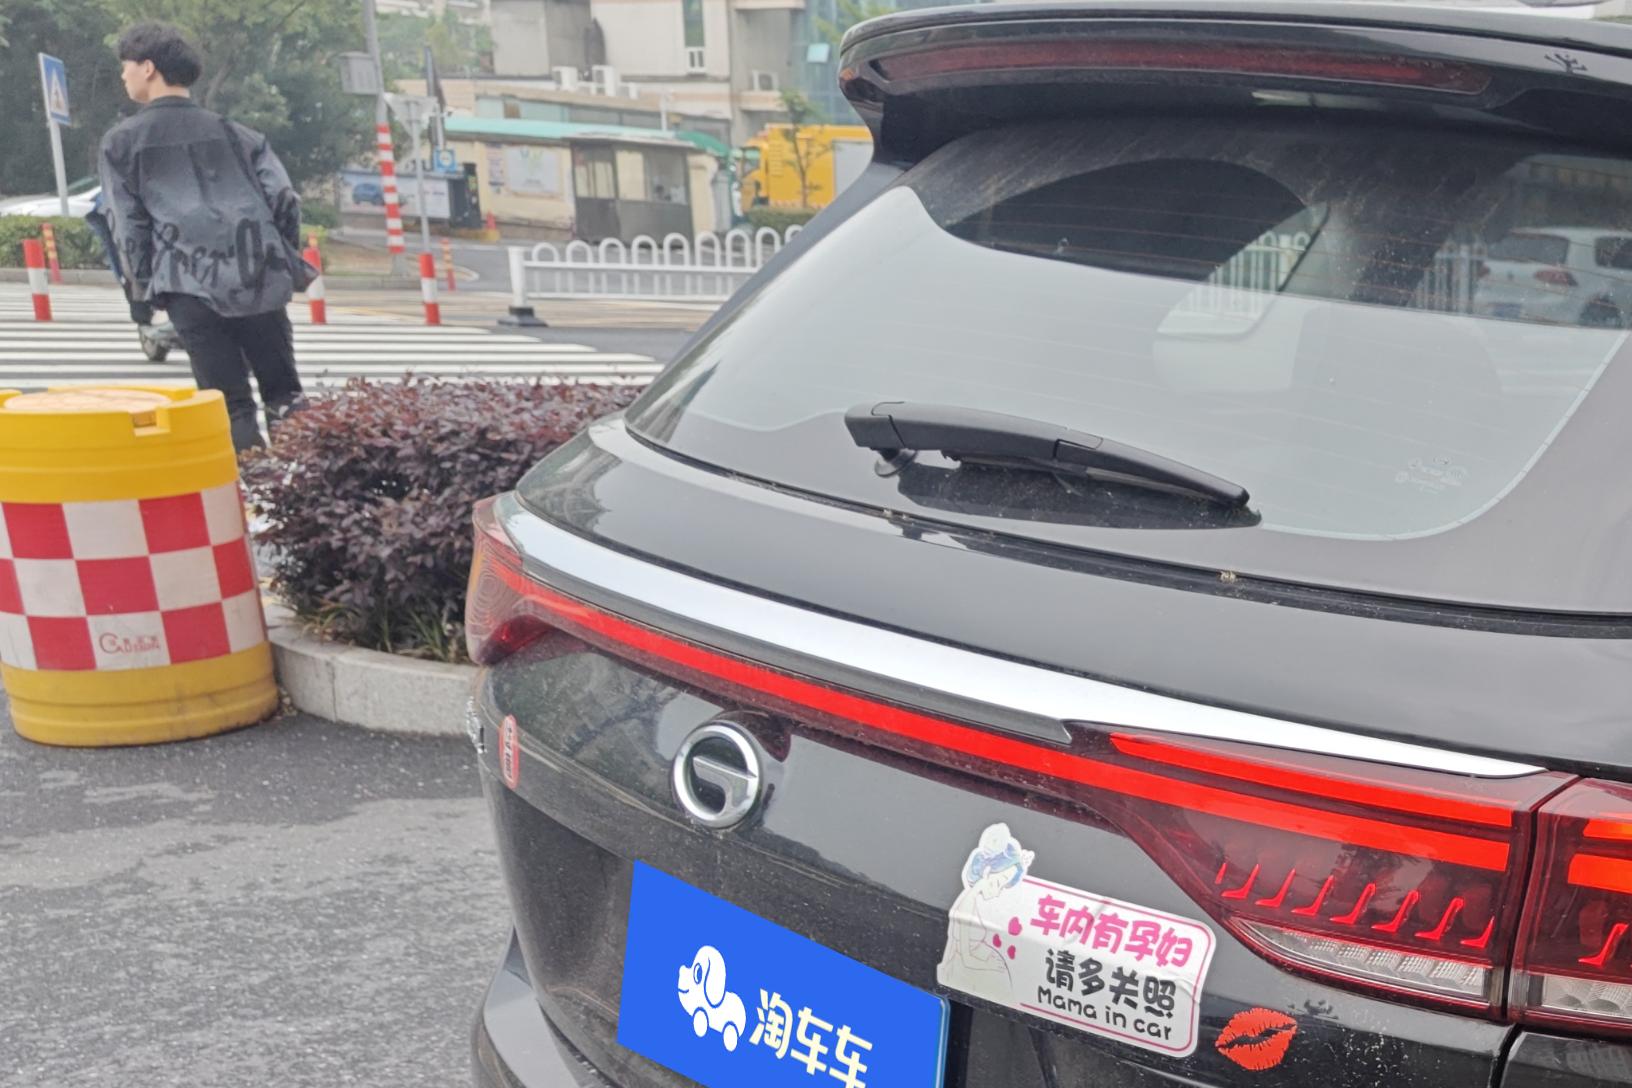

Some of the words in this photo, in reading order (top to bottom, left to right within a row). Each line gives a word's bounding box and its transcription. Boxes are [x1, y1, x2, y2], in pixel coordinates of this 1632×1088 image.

[1030, 894, 1193, 968] 车内有孕妇
[1037, 985, 1097, 1019] Mama
[1105, 1006, 1127, 1028] in
[1133, 1018, 1172, 1040] car
[1045, 948, 1176, 1019] 请多关照
